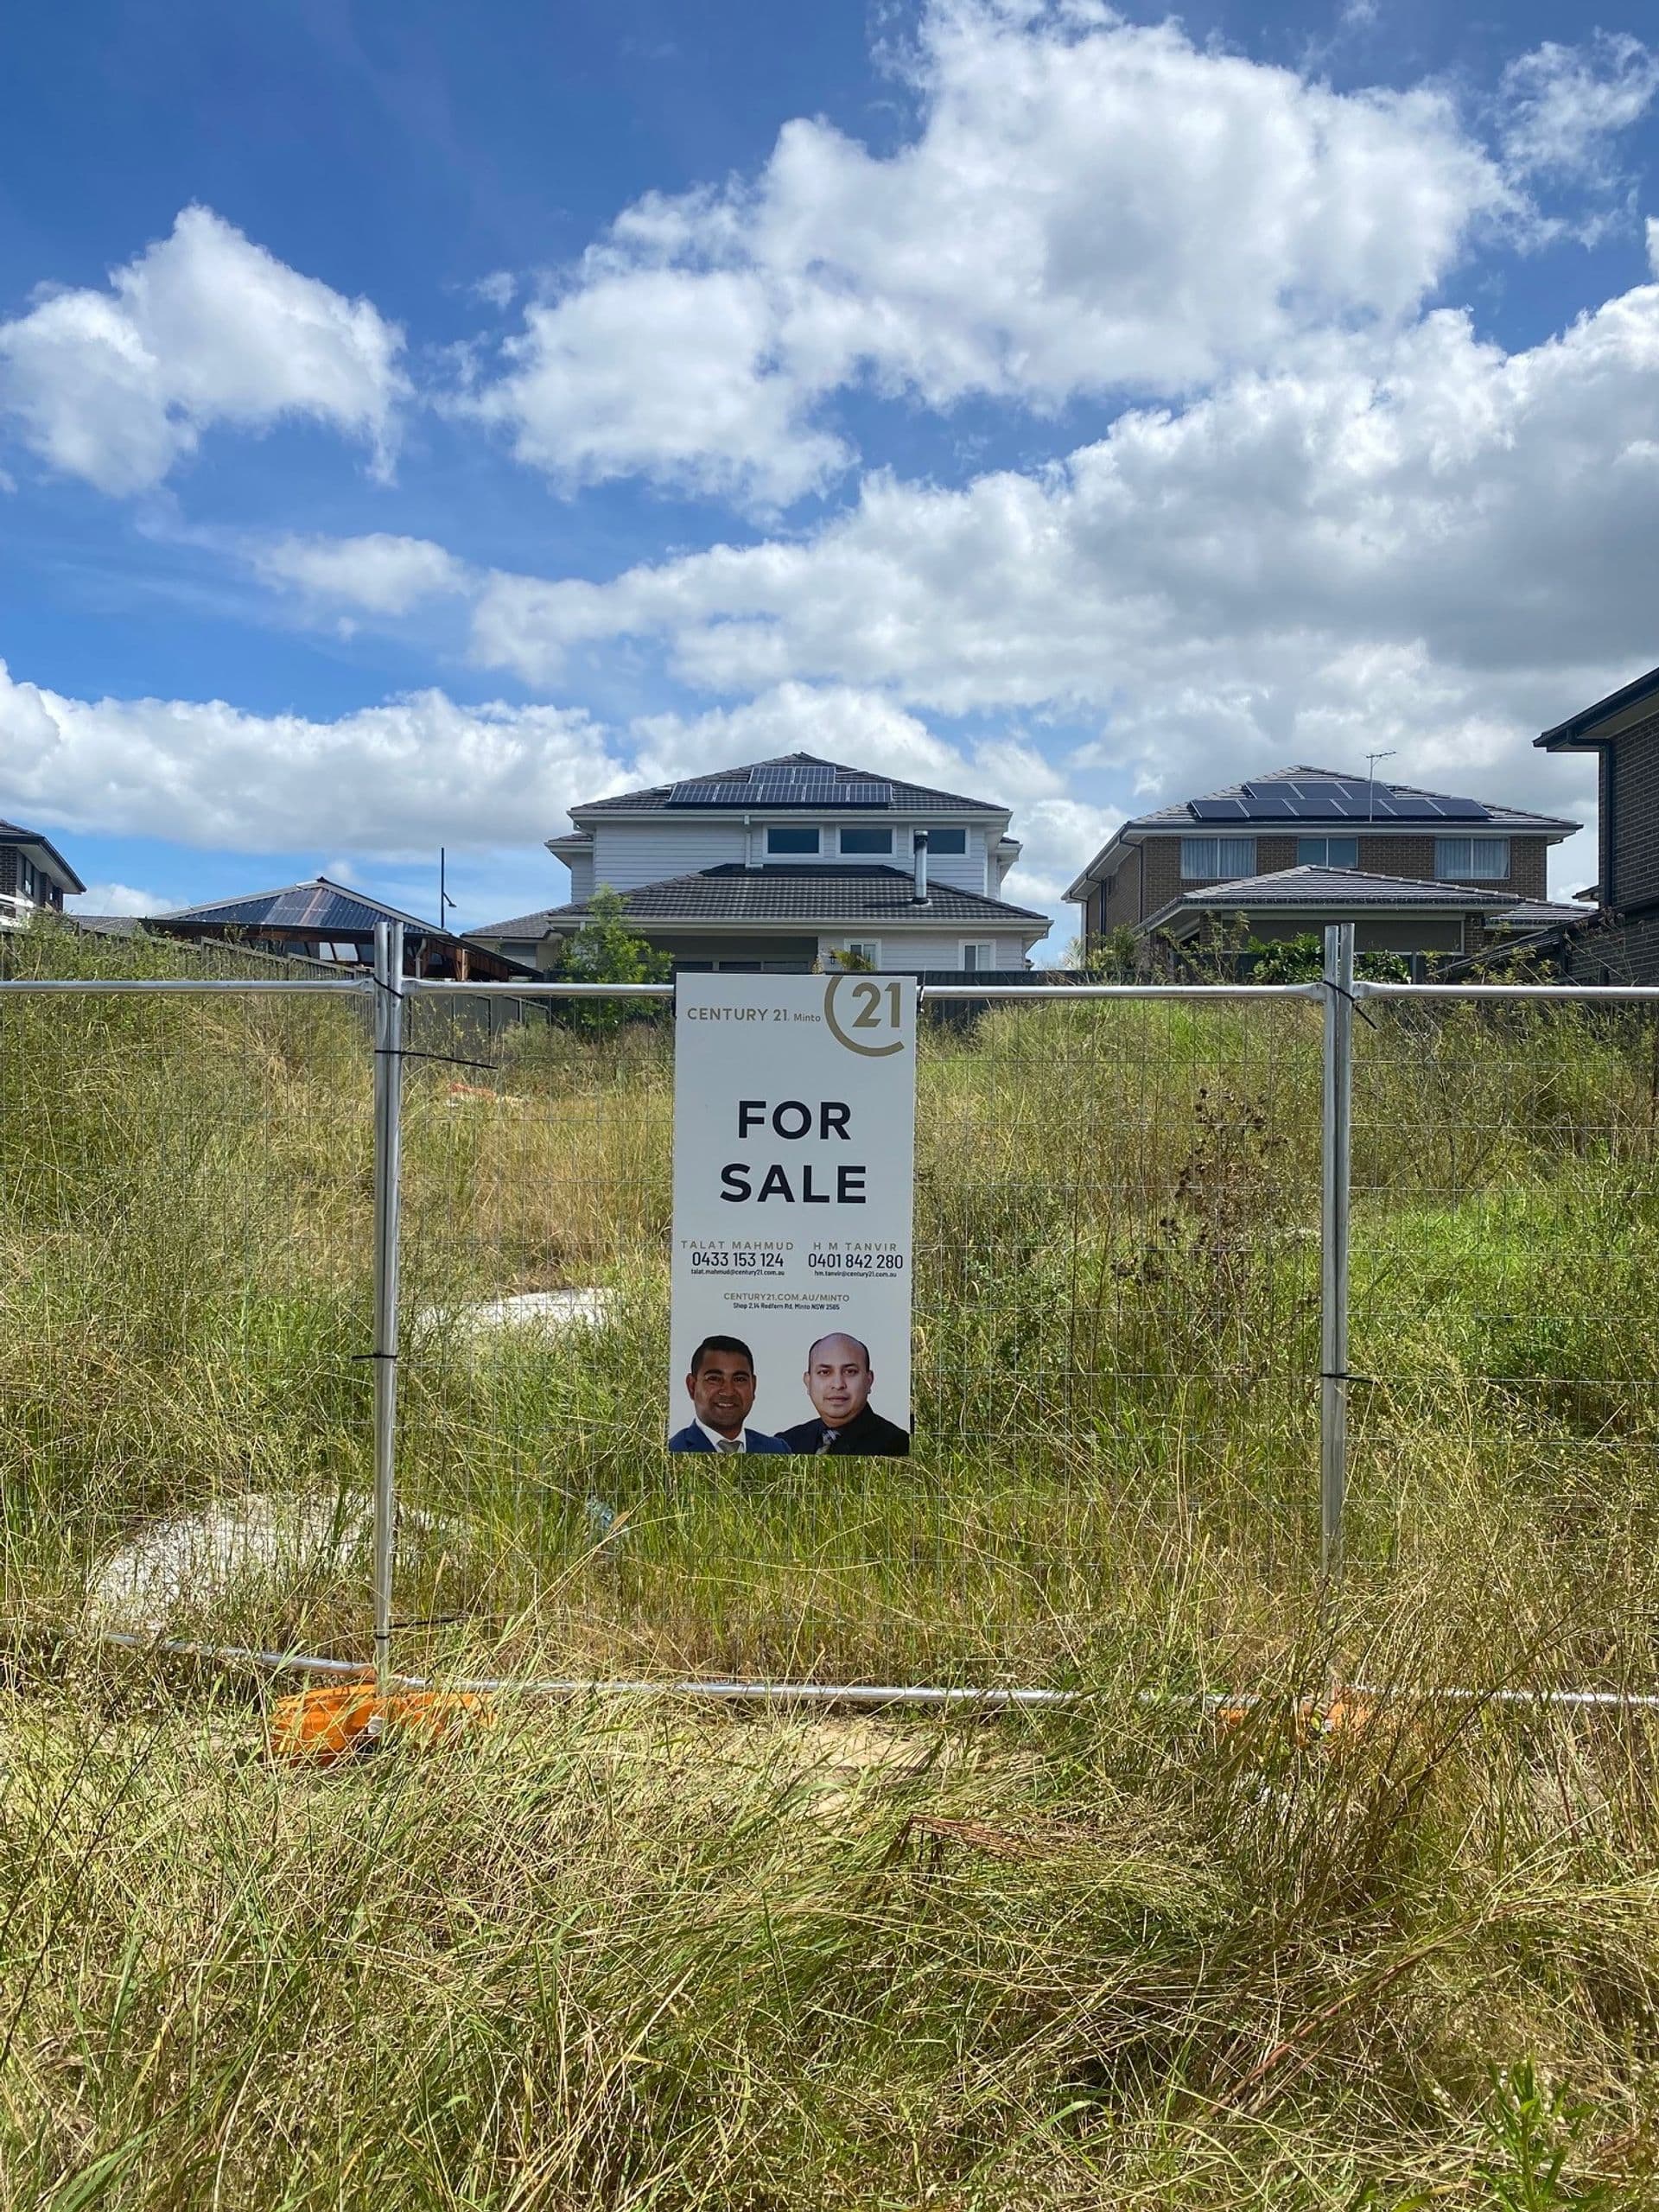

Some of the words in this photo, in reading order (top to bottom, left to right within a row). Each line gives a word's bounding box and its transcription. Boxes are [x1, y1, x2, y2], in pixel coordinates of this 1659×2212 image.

[687, 1007, 768, 1021] CENTURY
[793, 1013, 821, 1022] Minto
[738, 1100, 852, 1141] FOR
[719, 1163, 867, 1204] SALE
[681, 1241, 725, 1249] TALAT
[732, 1242, 794, 1251] MAHMUD
[846, 1243, 897, 1252] TANVIR
[691, 1251, 728, 1267] 0433
[733, 1252, 756, 1267] 153
[760, 1253, 784, 1268] 124
[808, 1253, 842, 1268] 0401
[845, 1254, 873, 1268] 842
[876, 1254, 904, 1269] 280
[723, 1292, 849, 1303] CENTURY21.COM.AU/MINTO
